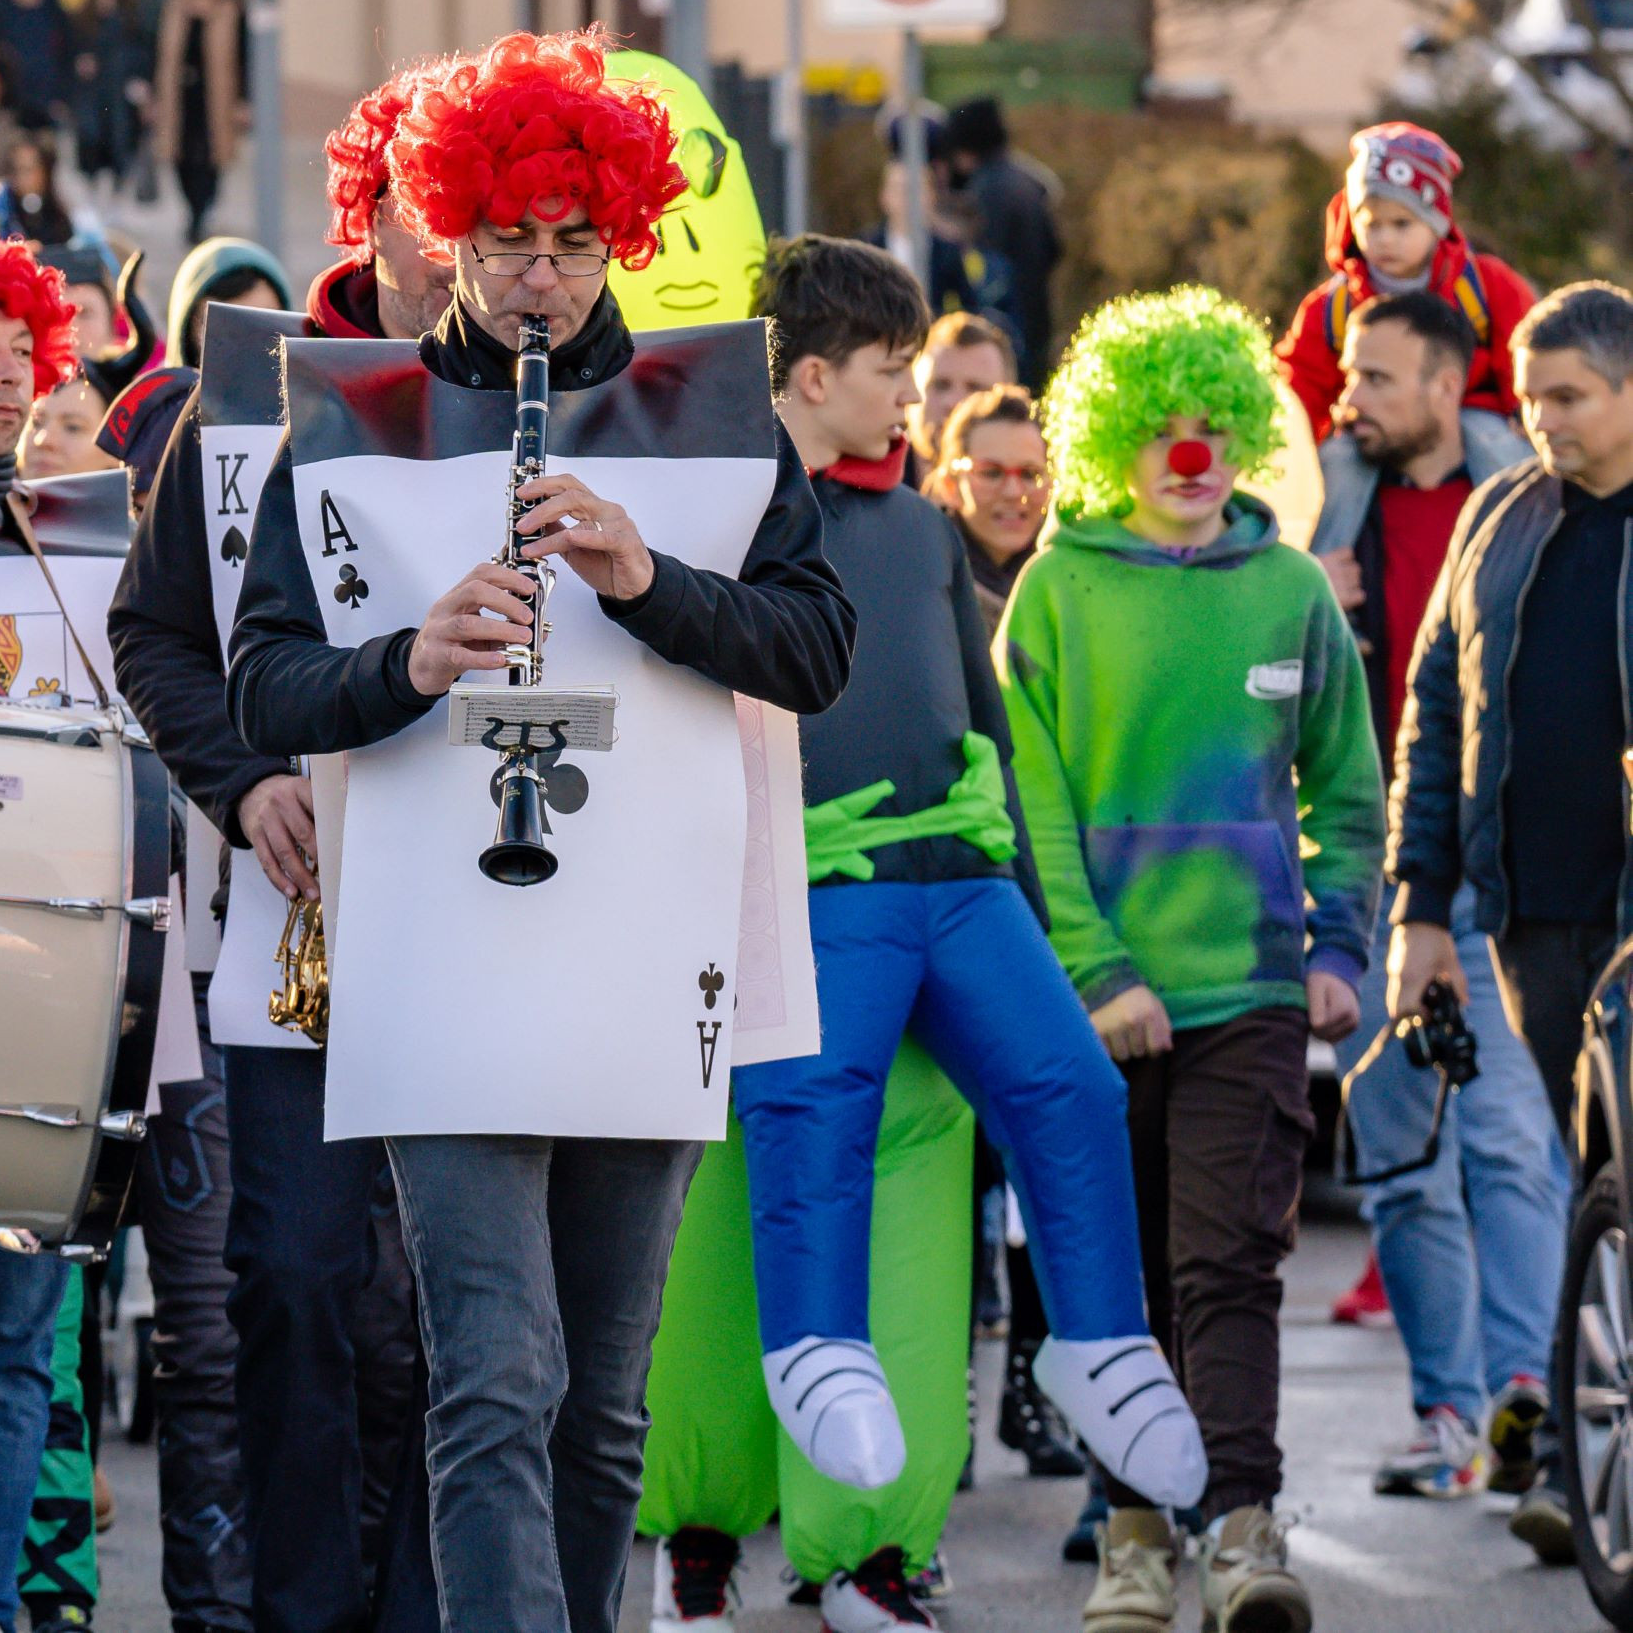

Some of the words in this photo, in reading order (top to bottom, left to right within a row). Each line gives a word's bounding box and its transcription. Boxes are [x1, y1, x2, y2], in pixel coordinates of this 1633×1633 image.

[215, 453, 249, 515] K
[320, 489, 359, 557] A
[696, 1021, 722, 1088] A
